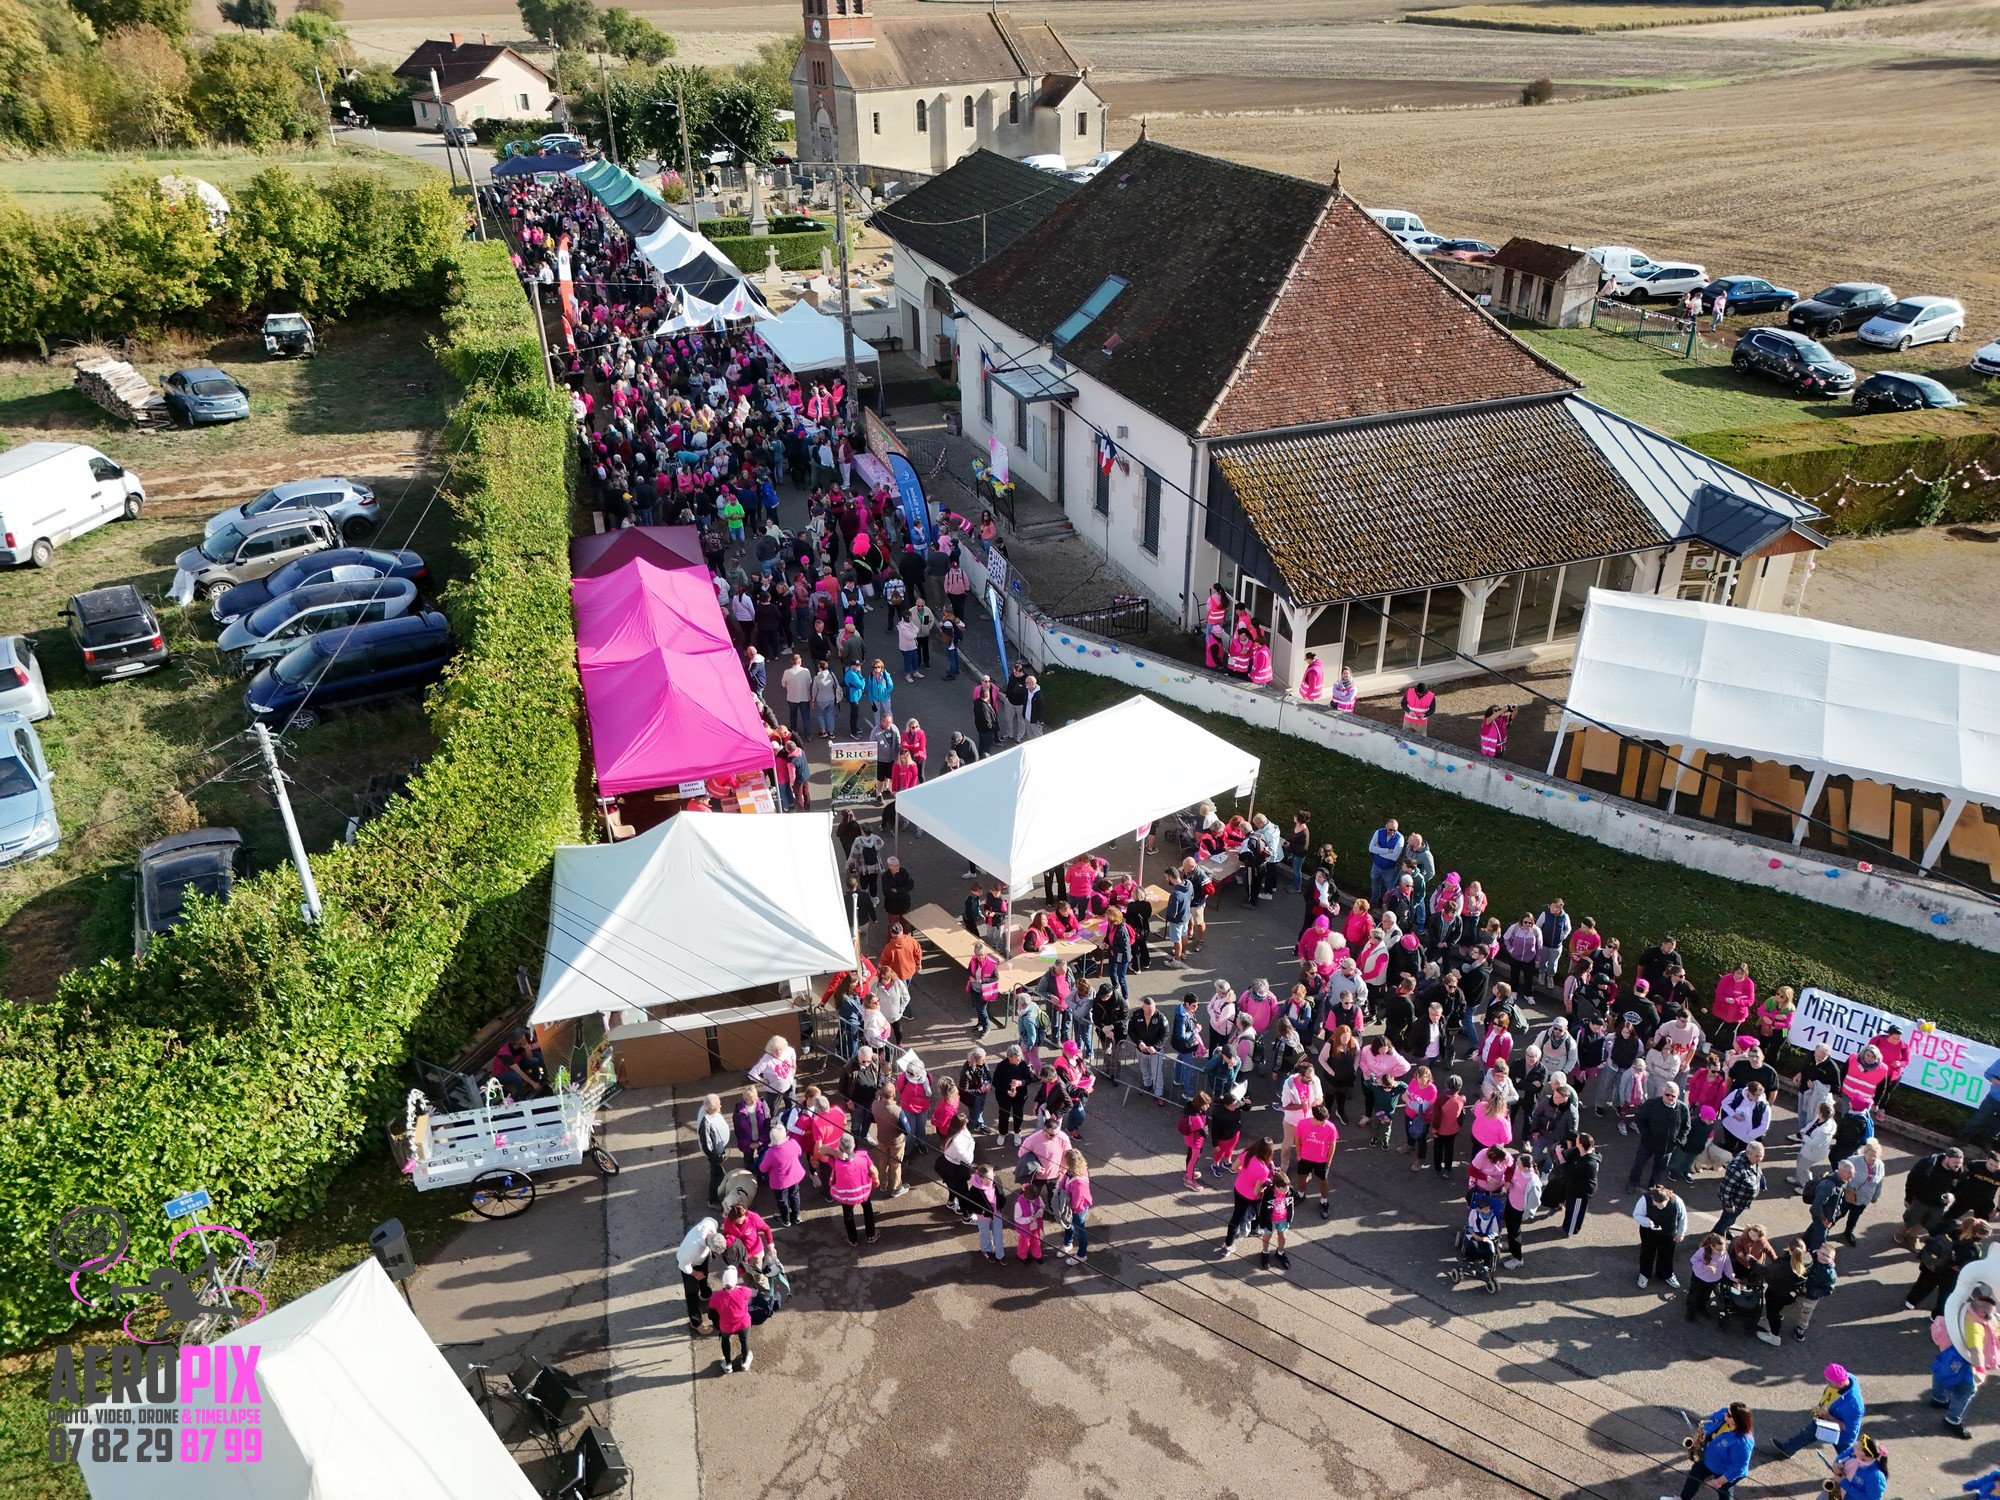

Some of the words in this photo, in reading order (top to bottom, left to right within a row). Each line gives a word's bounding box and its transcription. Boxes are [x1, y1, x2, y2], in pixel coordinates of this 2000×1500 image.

[835, 749, 874, 759] BRICE
[1803, 994, 1892, 1038] MARCHE
[1908, 1029, 1968, 1069] ROSE
[1803, 1025, 1829, 1044] 11
[1920, 1061, 1984, 1104] ESPO
[502, 1140, 557, 1156] BOIS
[179, 1197, 194, 1206] RUE
